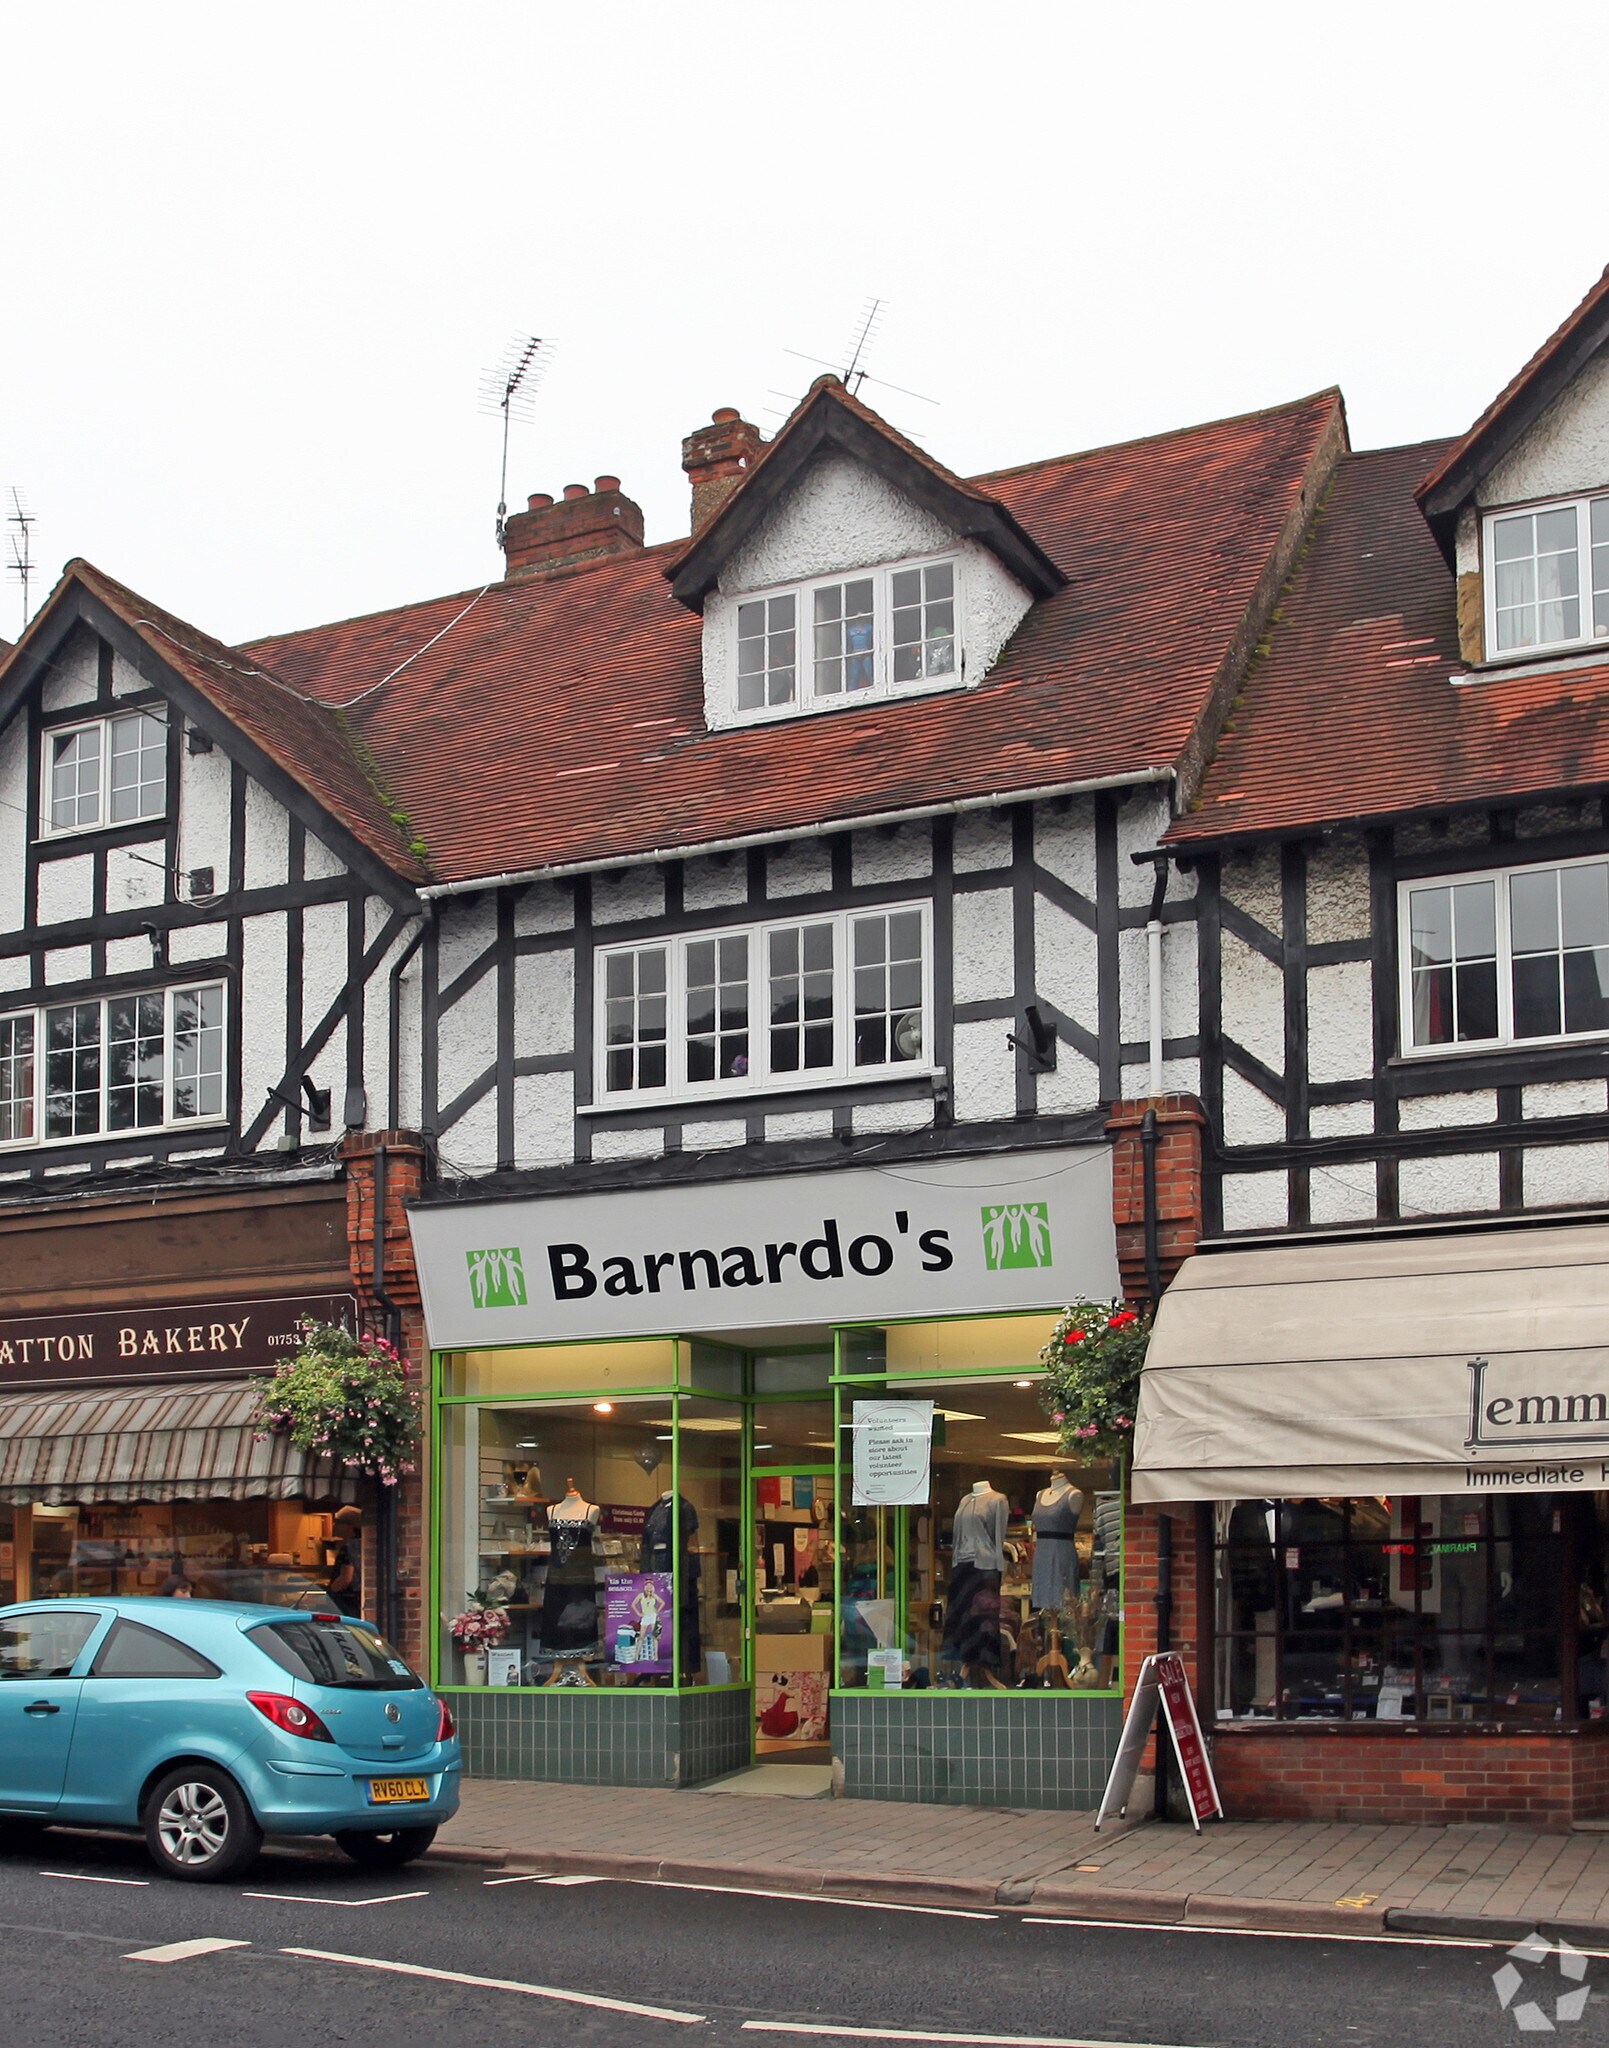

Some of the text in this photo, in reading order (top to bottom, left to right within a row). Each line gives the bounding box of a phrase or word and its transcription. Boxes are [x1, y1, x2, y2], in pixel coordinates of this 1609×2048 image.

[547, 1211, 953, 1300] Barnardo's
[0, 1316, 250, 1364] ATTON BAKERY
[869, 1461, 902, 1469] volunteer
[869, 1468, 917, 1478] opportunities
[1466, 1465, 1584, 1487] Immediate
[1160, 1661, 1184, 1686] SALE
[372, 1779, 427, 1798] RV60 CLX
